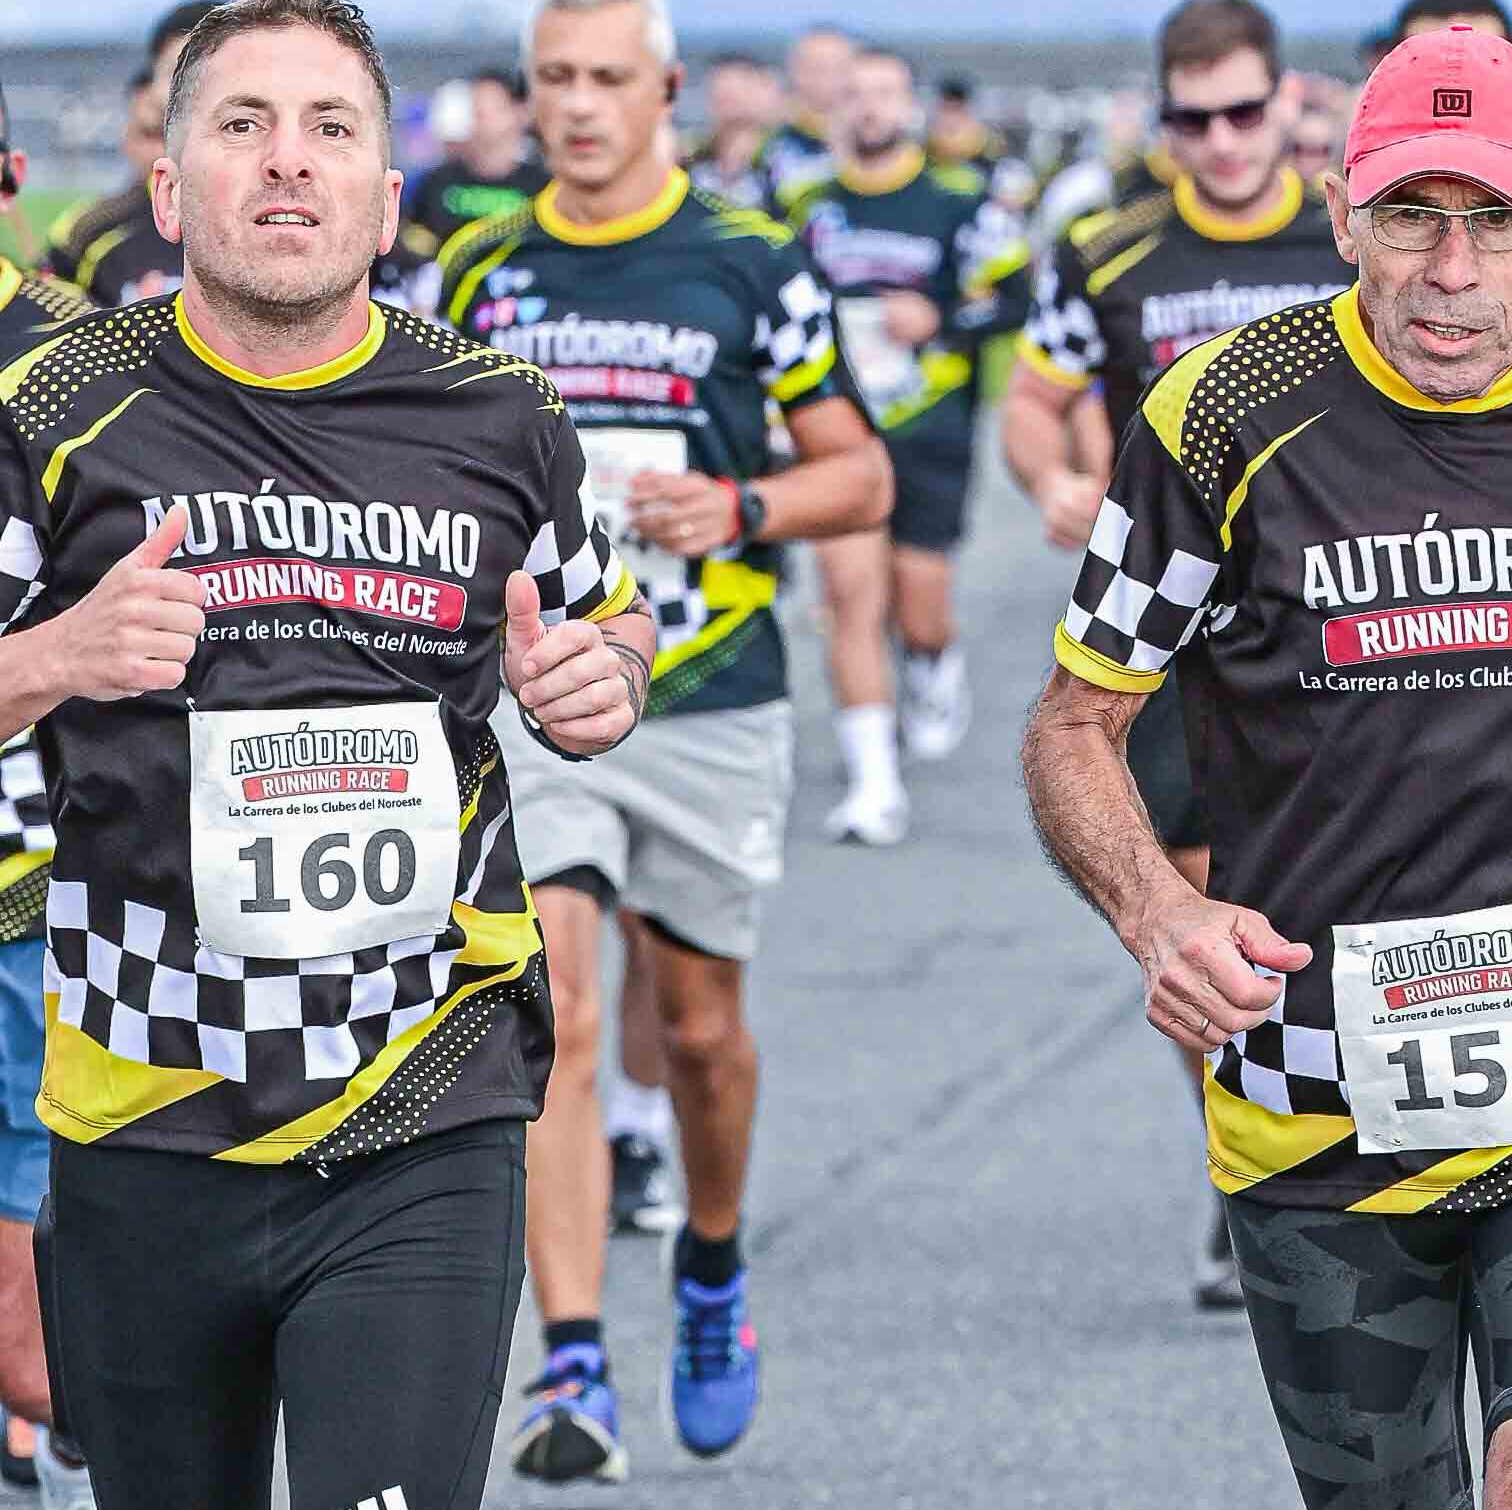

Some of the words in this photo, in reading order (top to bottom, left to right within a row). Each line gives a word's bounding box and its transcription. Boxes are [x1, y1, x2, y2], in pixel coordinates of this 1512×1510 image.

[203, 563, 344, 608] RUNNING
[353, 571, 441, 622] RACE
[245, 620, 270, 641] de
[274, 617, 304, 639] los
[373, 630, 406, 652] del
[408, 634, 468, 657] Noroeste
[1357, 606, 1508, 658] RUNNING
[1299, 670, 1323, 691] La
[1325, 672, 1398, 691] Carrera
[1404, 669, 1431, 690] de
[1435, 668, 1465, 689] los
[231, 722, 418, 775] AUTÓDROMO
[262, 770, 341, 798] RUNNING
[347, 770, 391, 791] RACE
[228, 806, 241, 817] La
[243, 804, 284, 817] Carrera
[286, 803, 301, 815] de
[303, 802, 319, 814] los
[321, 801, 357, 814] Clubes
[359, 798, 376, 810] del
[377, 796, 422, 810] Noroeste
[238, 828, 416, 914] 160
[1403, 972, 1482, 1006] RUNNING
[1372, 1013, 1386, 1025] La
[1387, 1009, 1428, 1024] Carrera
[1430, 1006, 1445, 1018] de
[1446, 1004, 1462, 1016] los
[1464, 1000, 1501, 1014] Clubes
